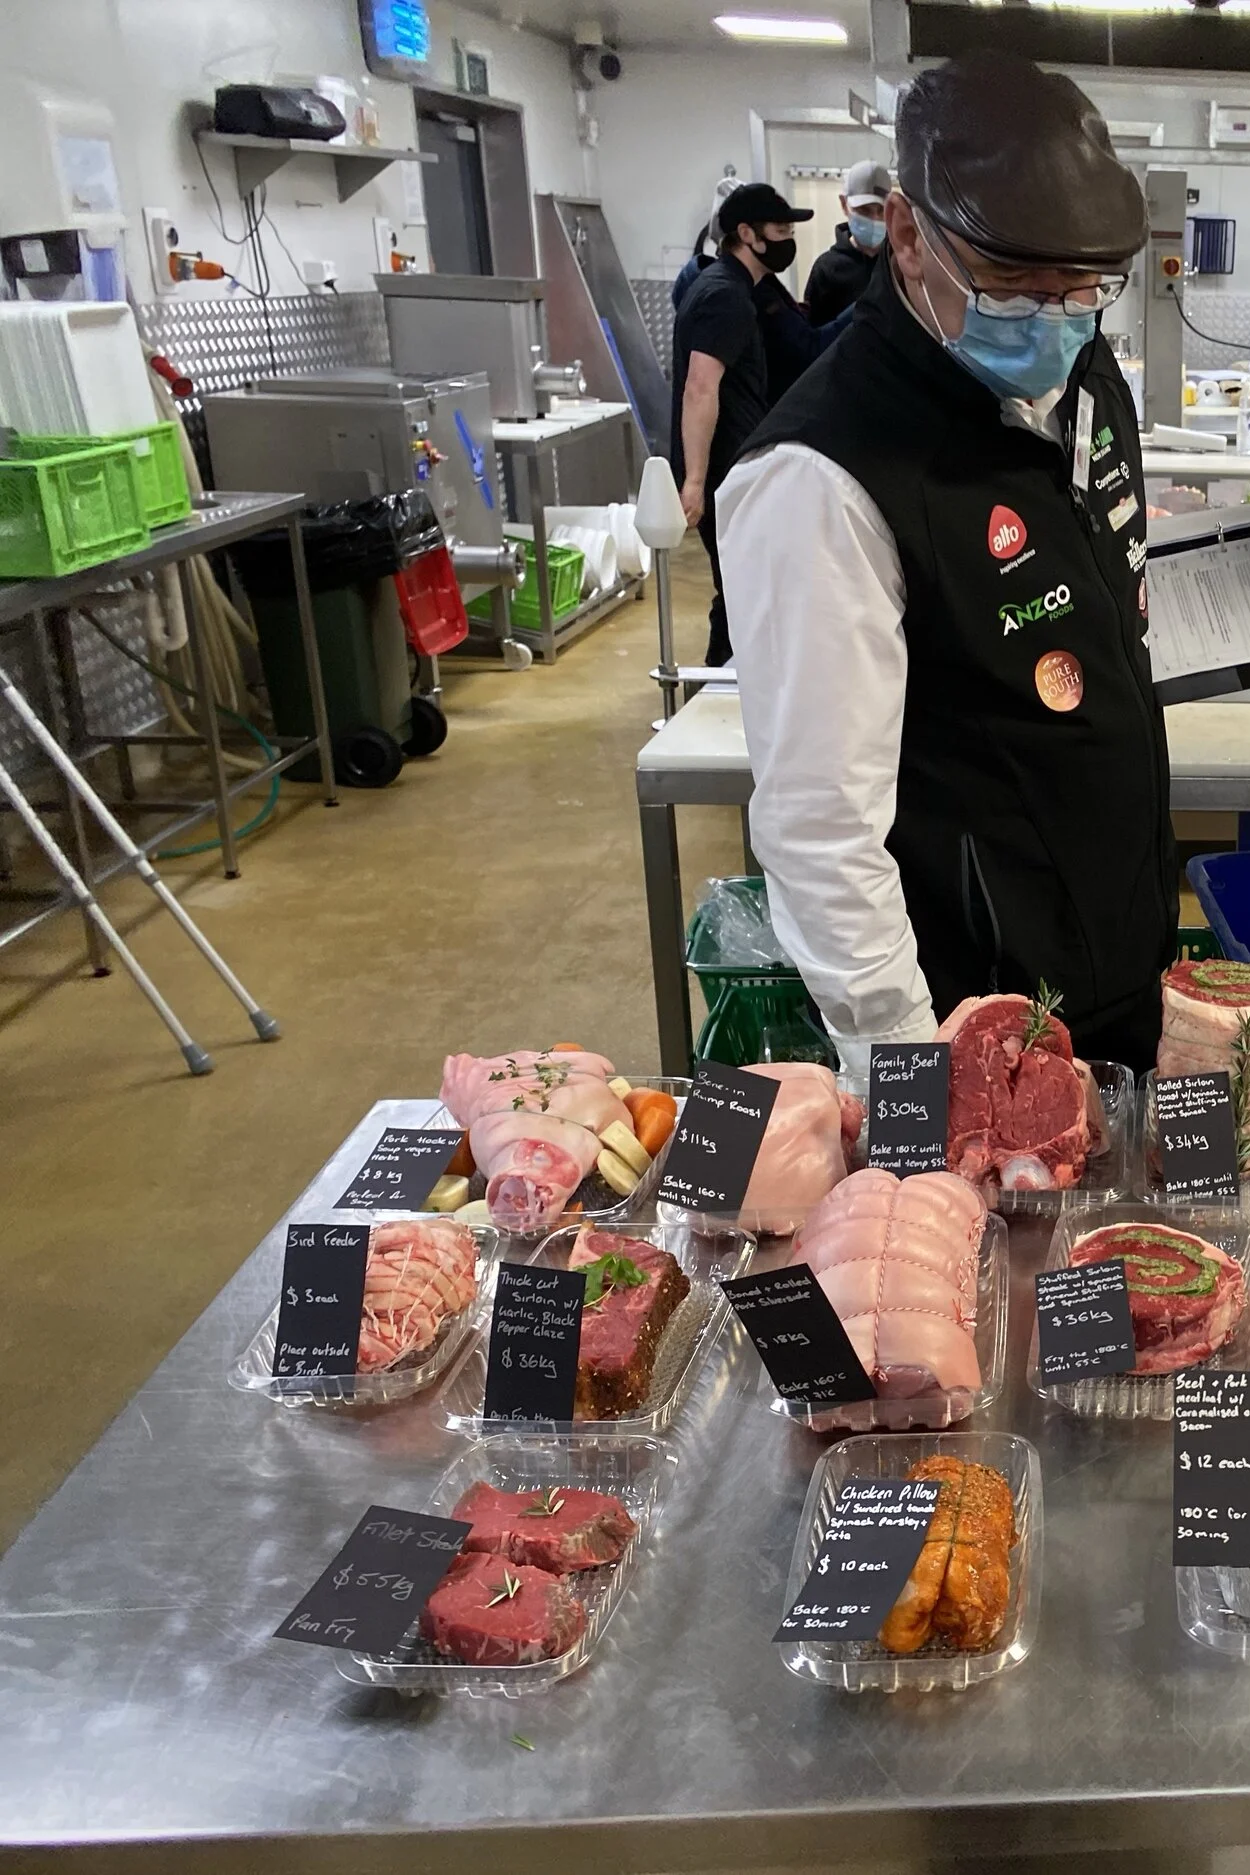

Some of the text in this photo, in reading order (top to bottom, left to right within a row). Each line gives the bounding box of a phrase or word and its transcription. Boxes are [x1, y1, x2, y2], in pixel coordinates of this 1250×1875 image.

[993, 524, 1019, 552] alto
[1004, 584, 1070, 636] ANZCO
[1049, 602, 1074, 623] FOODS
[1043, 663, 1072, 686] PURE
[1044, 671, 1080, 700] SOUTH
[872, 1052, 939, 1069] Family Beef
[879, 1070, 915, 1082] Roast
[1157, 1078, 1214, 1091] Rolled Sirloin
[693, 1089, 761, 1118] Rump Roast
[1157, 1091, 1178, 1102] Roast
[878, 1100, 928, 1120] $30kg
[383, 1135, 446, 1145] Pork Hock
[679, 1128, 716, 1153] $11kg
[377, 1144, 431, 1156] Soup veges
[871, 1144, 892, 1155] Bake
[920, 1143, 942, 1153] until
[905, 1159, 928, 1170] temp
[663, 1176, 692, 1191] Bake
[1166, 1182, 1187, 1192] Bake
[1214, 1173, 1233, 1183] until
[347, 1190, 406, 1200] Perfect for
[658, 1189, 678, 1200] until
[288, 1229, 360, 1247] Bird Feeder
[501, 1271, 532, 1286] Thick
[1038, 1271, 1081, 1285] Stuffed
[726, 1277, 812, 1299] Boned Rolled
[512, 1291, 579, 1311] Sirloin w/
[735, 1291, 811, 1311] Pork Silverside
[542, 1312, 576, 1326] Black
[497, 1321, 565, 1340] Pepper Glaze
[280, 1343, 350, 1356] Place outside
[278, 1358, 290, 1373] for
[1045, 1355, 1064, 1364] Fry
[1045, 1362, 1070, 1373] until
[779, 1381, 810, 1394] Bake
[1176, 1374, 1248, 1389] Beef Pork
[1179, 1421, 1212, 1432] Bacon
[841, 1483, 938, 1500] Chicken Pillow
[836, 1502, 902, 1514] w/ Sundried
[1228, 1507, 1247, 1519] for
[830, 1516, 919, 1530] Spinach Parsley
[362, 1521, 415, 1543] Fillet
[825, 1531, 851, 1540] Feta
[793, 1604, 829, 1615] Bake
[289, 1613, 357, 1643] Pan Fry
[782, 1618, 798, 1627] for
